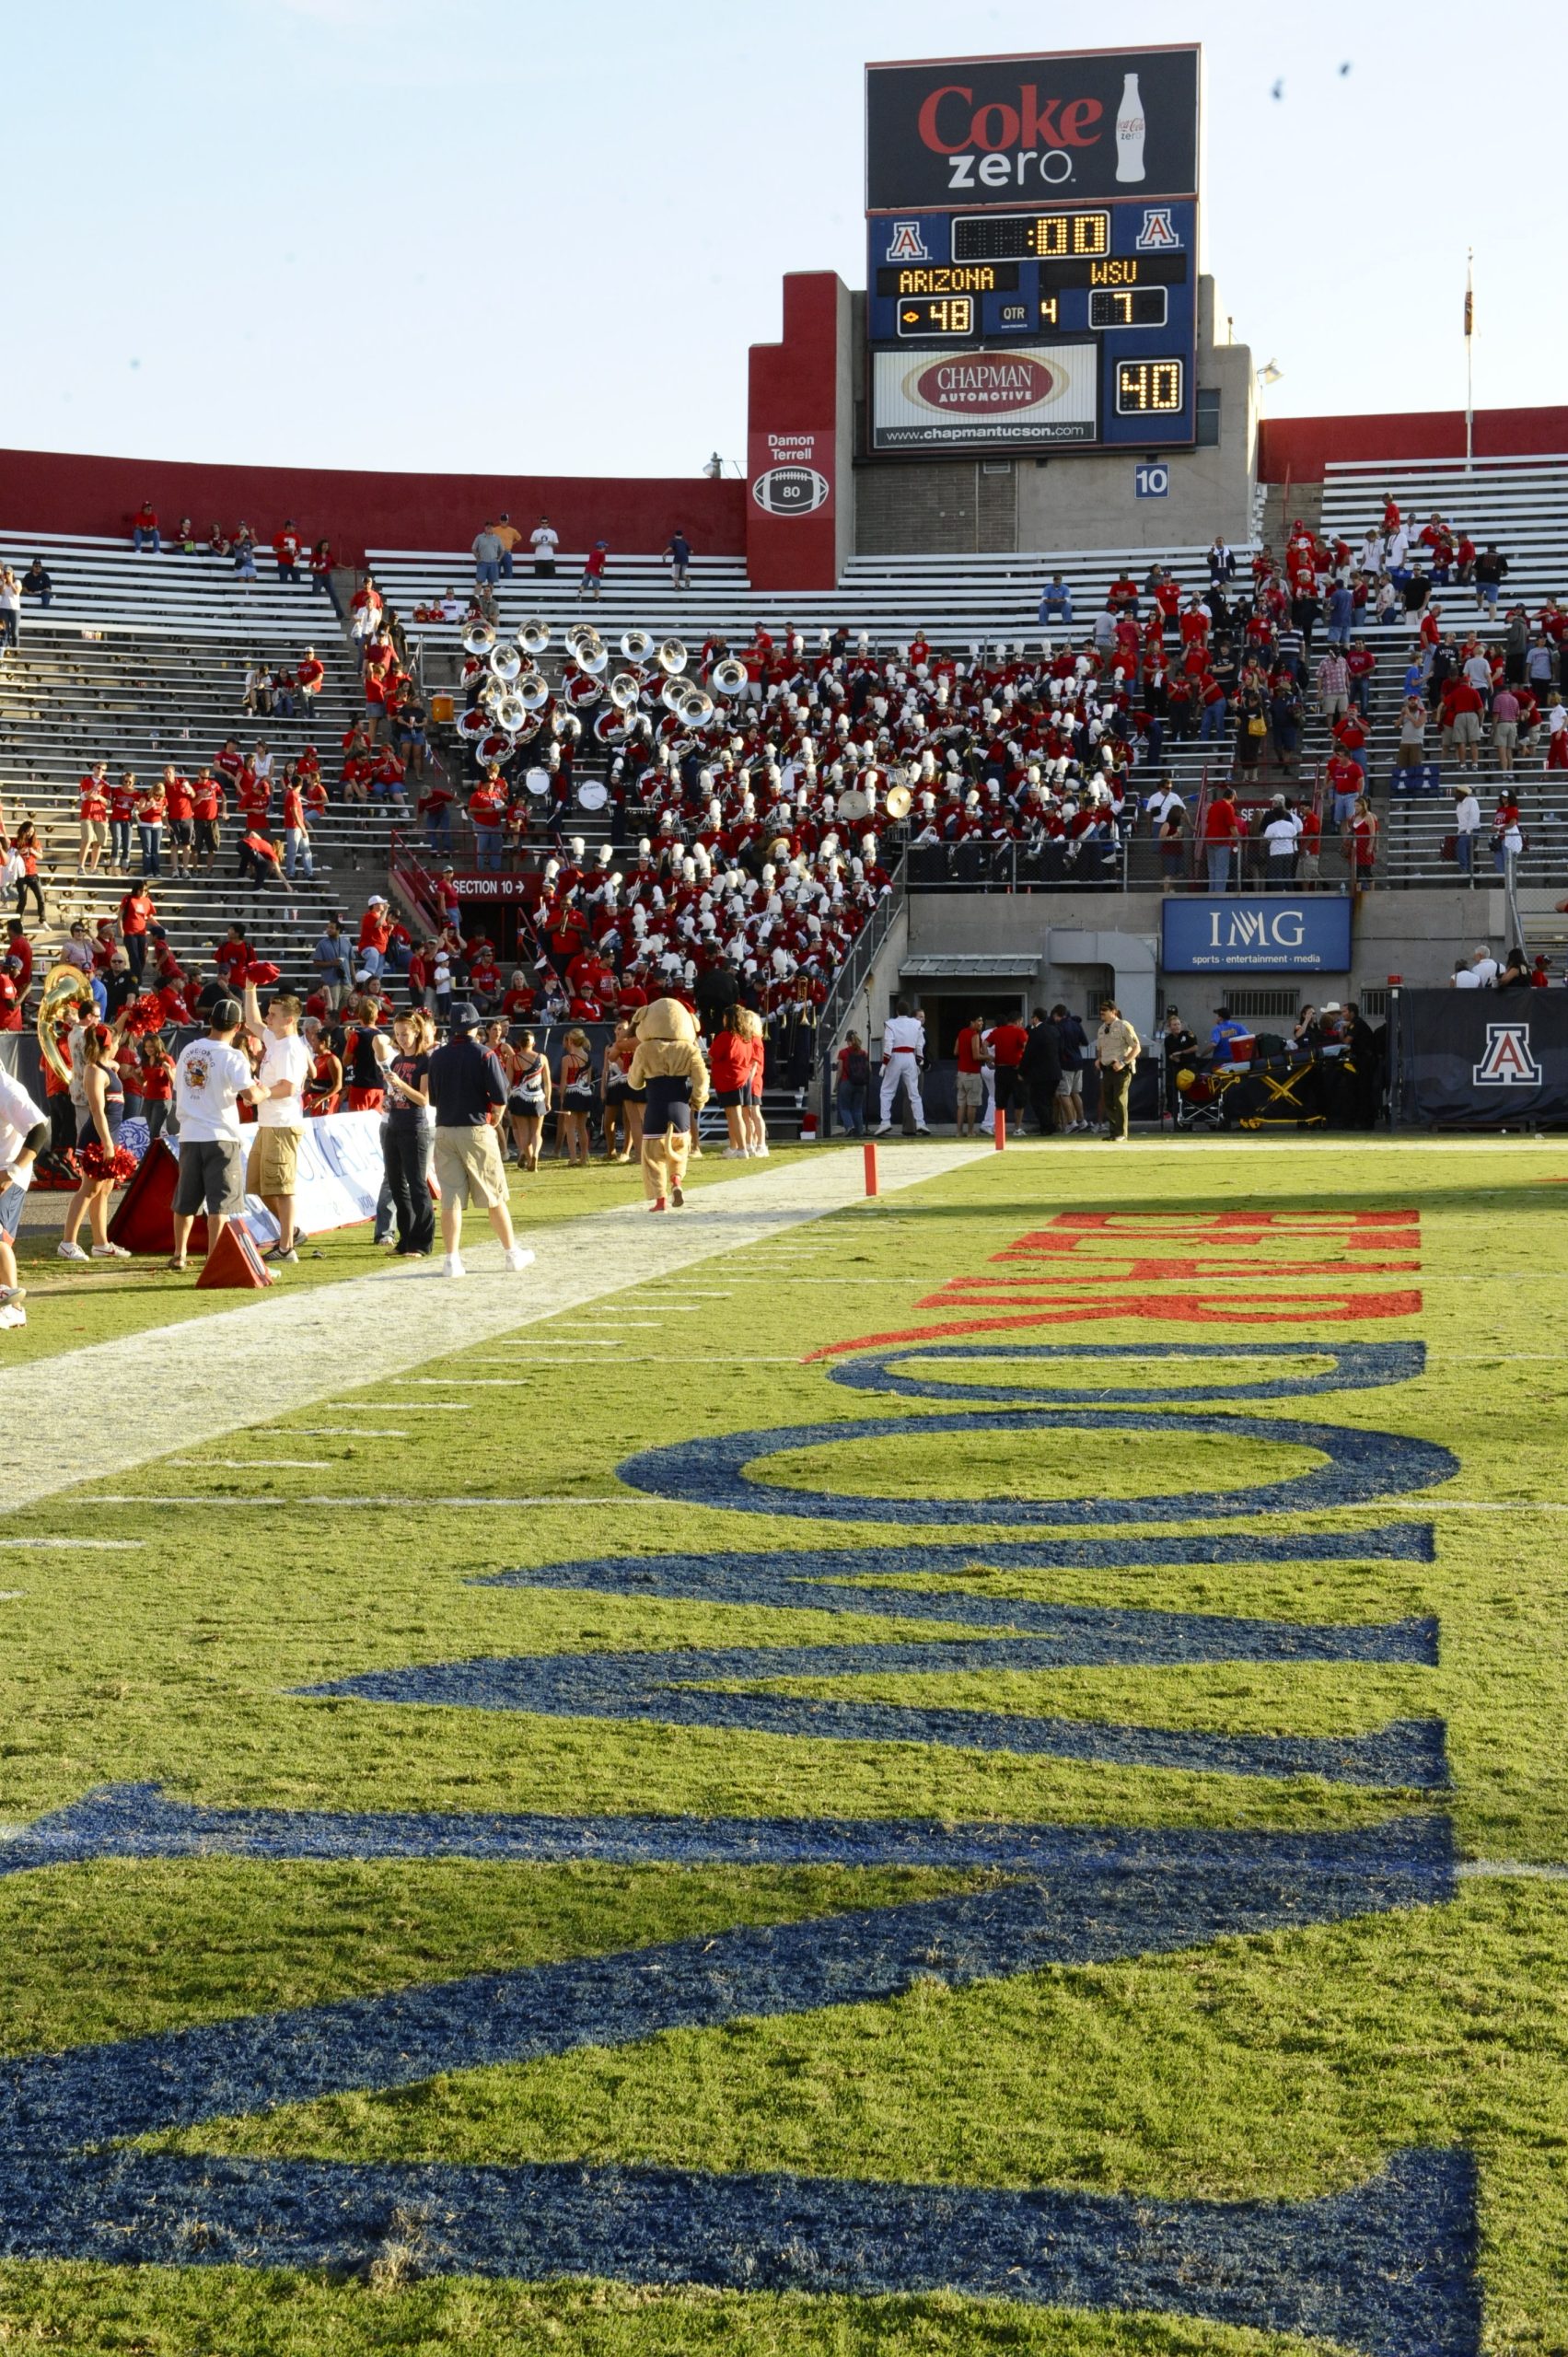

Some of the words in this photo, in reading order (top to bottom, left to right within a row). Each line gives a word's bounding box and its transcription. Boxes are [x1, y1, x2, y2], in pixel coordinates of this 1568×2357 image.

[918, 84, 1104, 155] Coke
[948, 150, 1073, 189] zero
[886, 221, 928, 261] A
[1136, 208, 1179, 250] A
[900, 267, 994, 293] ARIZONA
[1091, 261, 1137, 284] WSU
[930, 300, 970, 331] 48
[1041, 298, 1056, 324] 4
[1113, 293, 1132, 323] 7
[936, 365, 1034, 390] CHAPMAN
[1121, 364, 1179, 410] 40
[938, 390, 1033, 403] AUTOMOTIVE
[768, 435, 815, 447] Damon
[886, 425, 1085, 441] www.chapmantucson.com
[771, 447, 812, 460] Terrell
[783, 486, 801, 498] 80
[1136, 469, 1167, 493] 10
[452, 880, 497, 895] SECTION
[501, 880, 513, 895] 10
[1209, 911, 1306, 946] IMG
[1191, 955, 1220, 965] sports
[1225, 954, 1288, 964] entertainment
[1294, 954, 1321, 964] media
[1473, 1023, 1542, 1086] A
[801, 1210, 1423, 1364] BEAR
[0, 1340, 1485, 2357] DOWN
